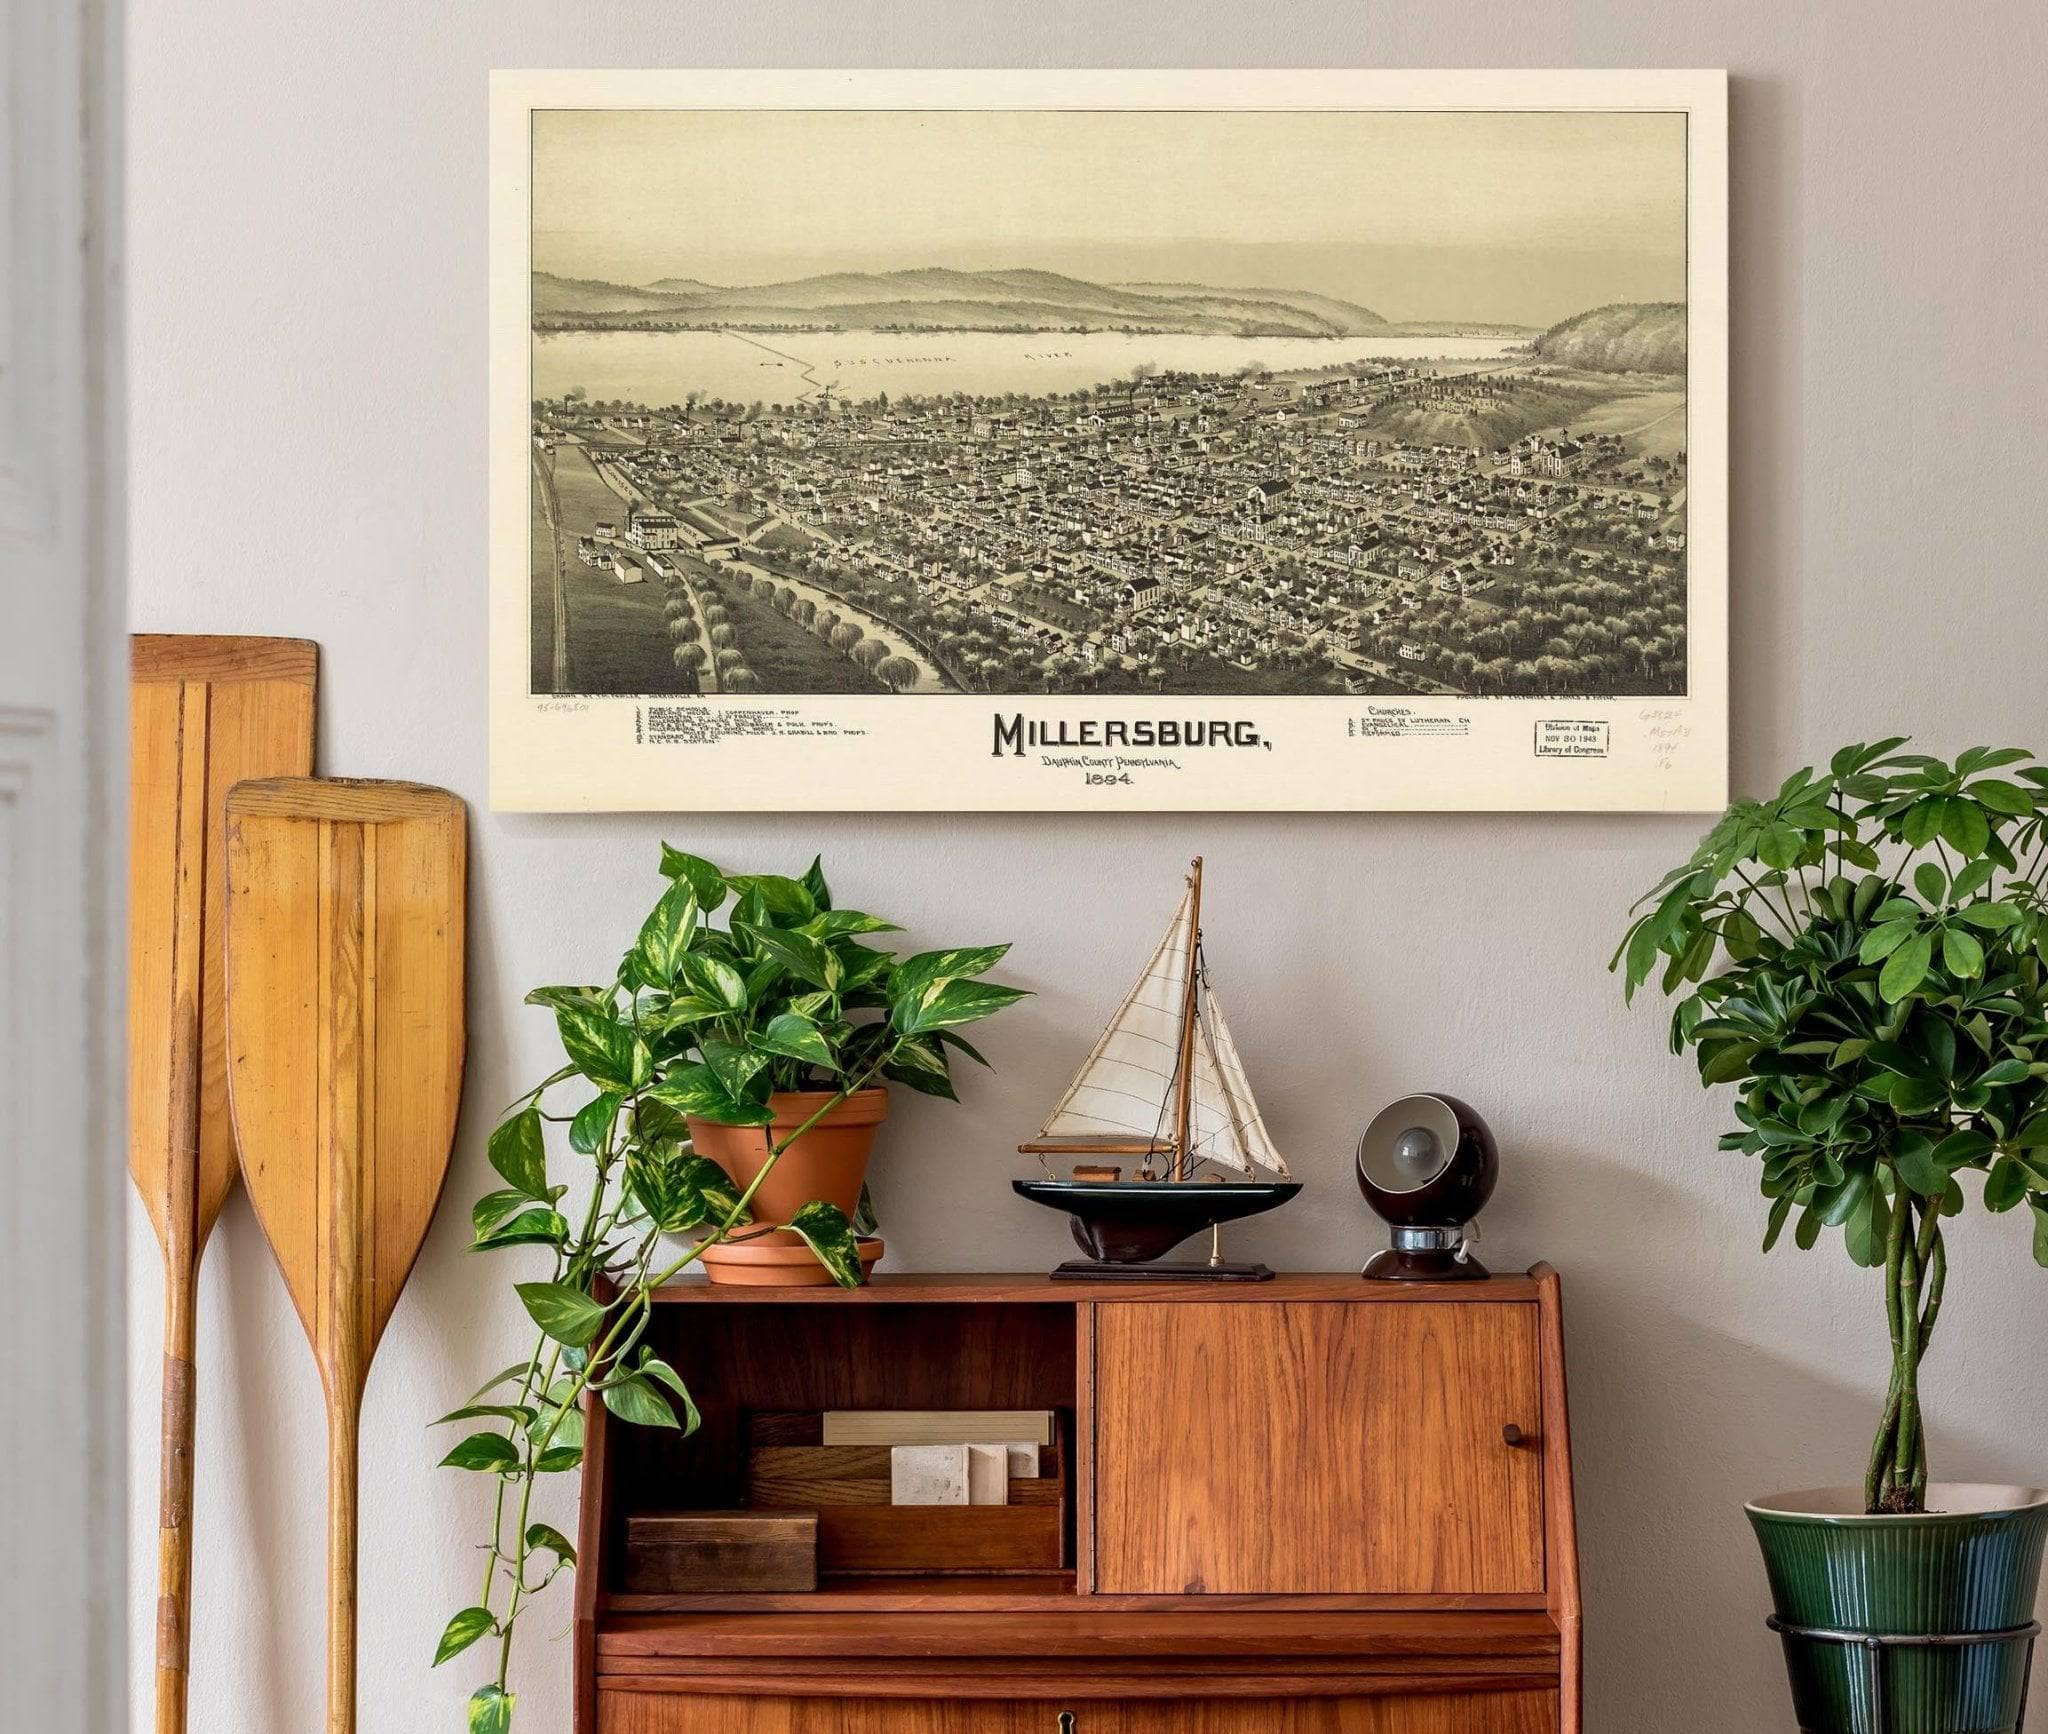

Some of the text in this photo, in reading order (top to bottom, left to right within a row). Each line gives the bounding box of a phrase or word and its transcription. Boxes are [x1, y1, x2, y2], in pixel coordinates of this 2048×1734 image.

[991, 712, 1272, 757] MILLERSBURG,
[1539, 745, 1604, 755] Library of Congress
